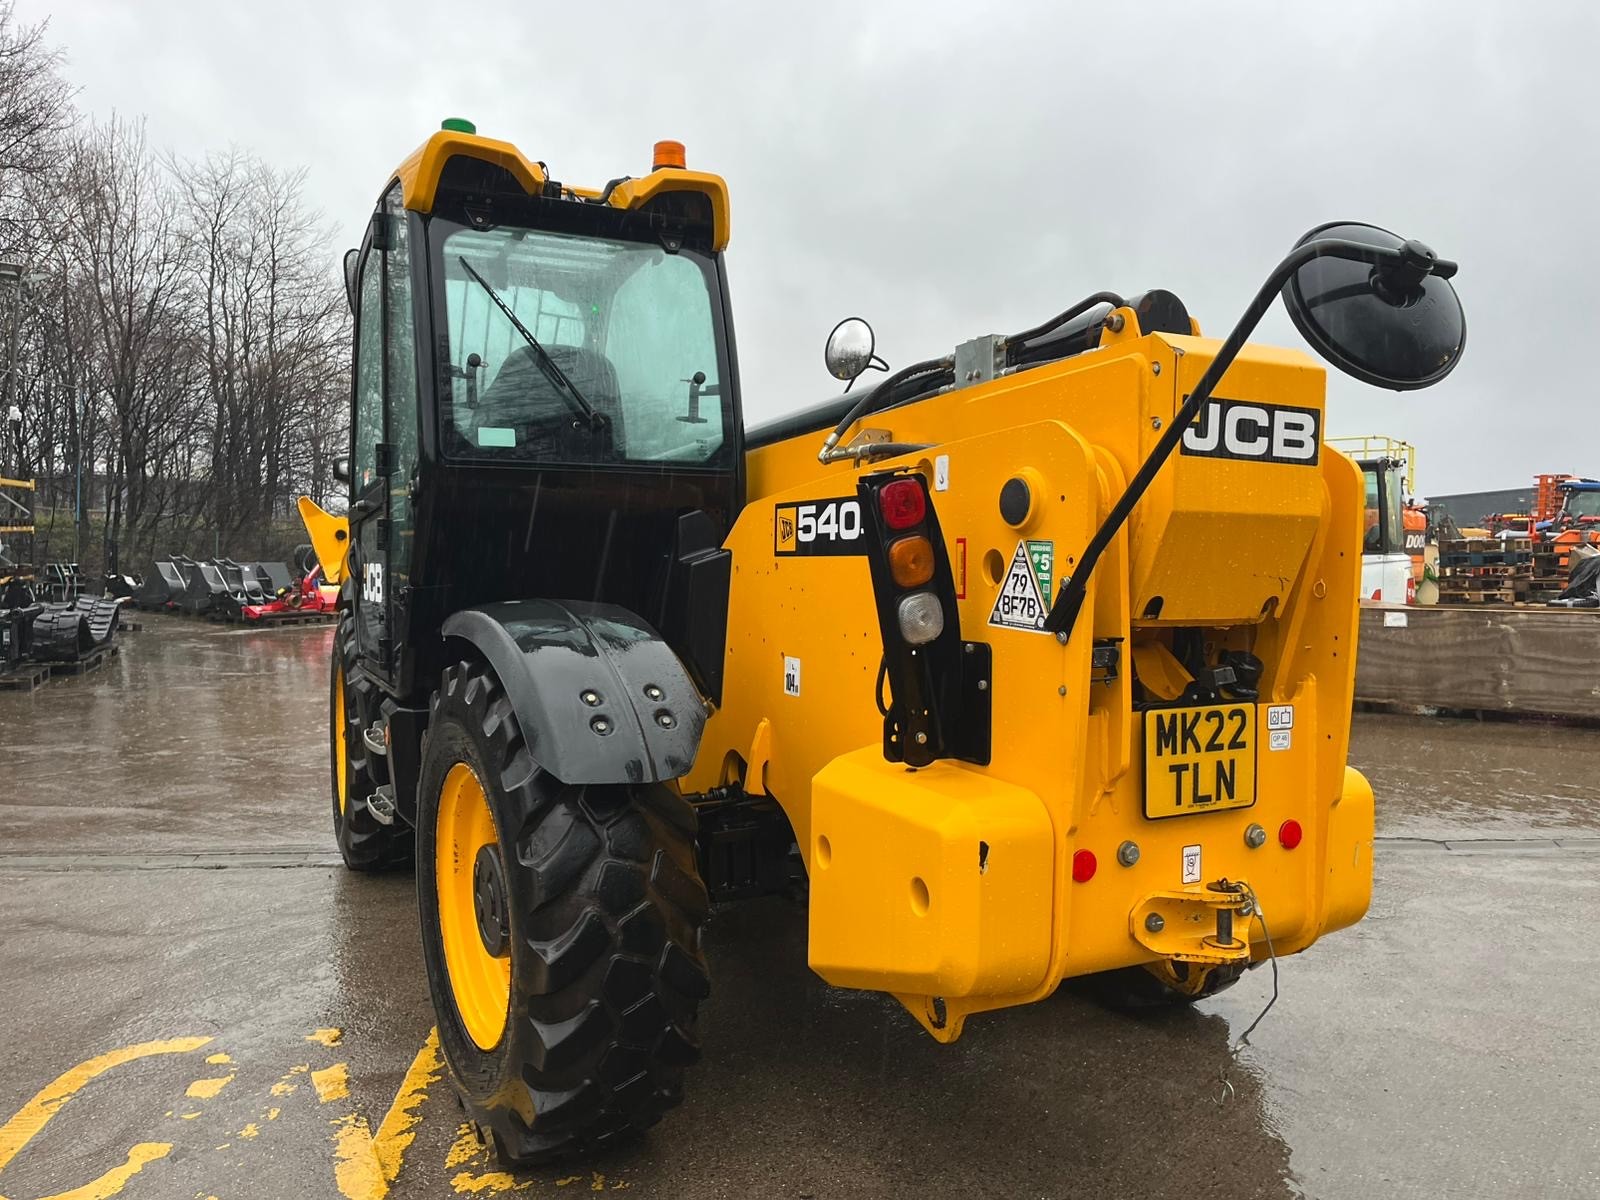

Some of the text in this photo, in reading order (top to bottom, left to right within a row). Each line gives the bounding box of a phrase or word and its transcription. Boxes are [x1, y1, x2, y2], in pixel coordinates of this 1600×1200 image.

[1183, 403, 1315, 460] JCB
[363, 562, 383, 603] JCB
[1012, 573, 1028, 594] 79
[1040, 553, 1050, 571] 5
[1156, 709, 1247, 756] MK22
[1168, 759, 1236, 806] TLN
